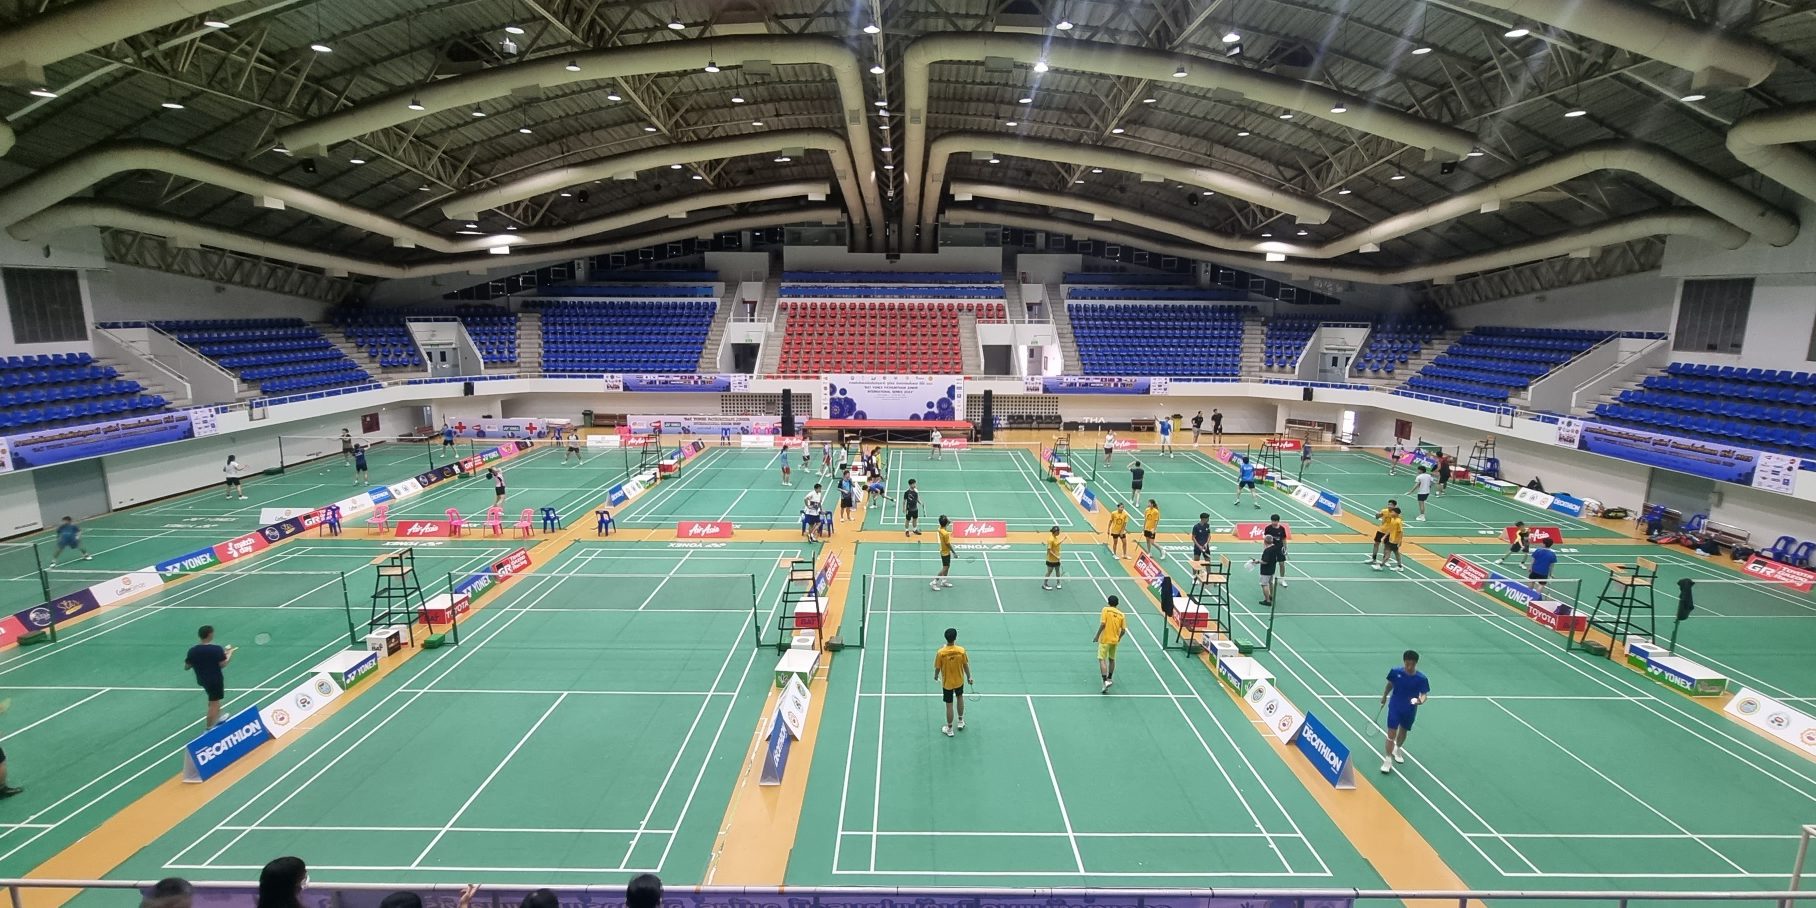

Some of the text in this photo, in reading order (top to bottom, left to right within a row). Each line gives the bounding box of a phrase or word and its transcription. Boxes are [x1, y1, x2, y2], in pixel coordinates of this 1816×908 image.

[407, 523, 439, 535] AirAsia
[688, 524, 720, 536] AirAsia
[964, 523, 995, 536] AirAsia
[234, 537, 255, 549] match
[239, 545, 253, 554] day
[182, 553, 214, 571] YONEX
[1446, 562, 1462, 575] GR
[498, 564, 512, 578] GR
[1748, 563, 1777, 578] GR
[472, 573, 491, 593] YONEX
[1504, 586, 1533, 607] YONEX
[1528, 606, 1556, 626] TOYOTA
[357, 658, 376, 676] YONEX
[1664, 670, 1693, 690] YONEX
[196, 719, 262, 766] DECATHLON
[1301, 725, 1343, 772] DECATHLON
